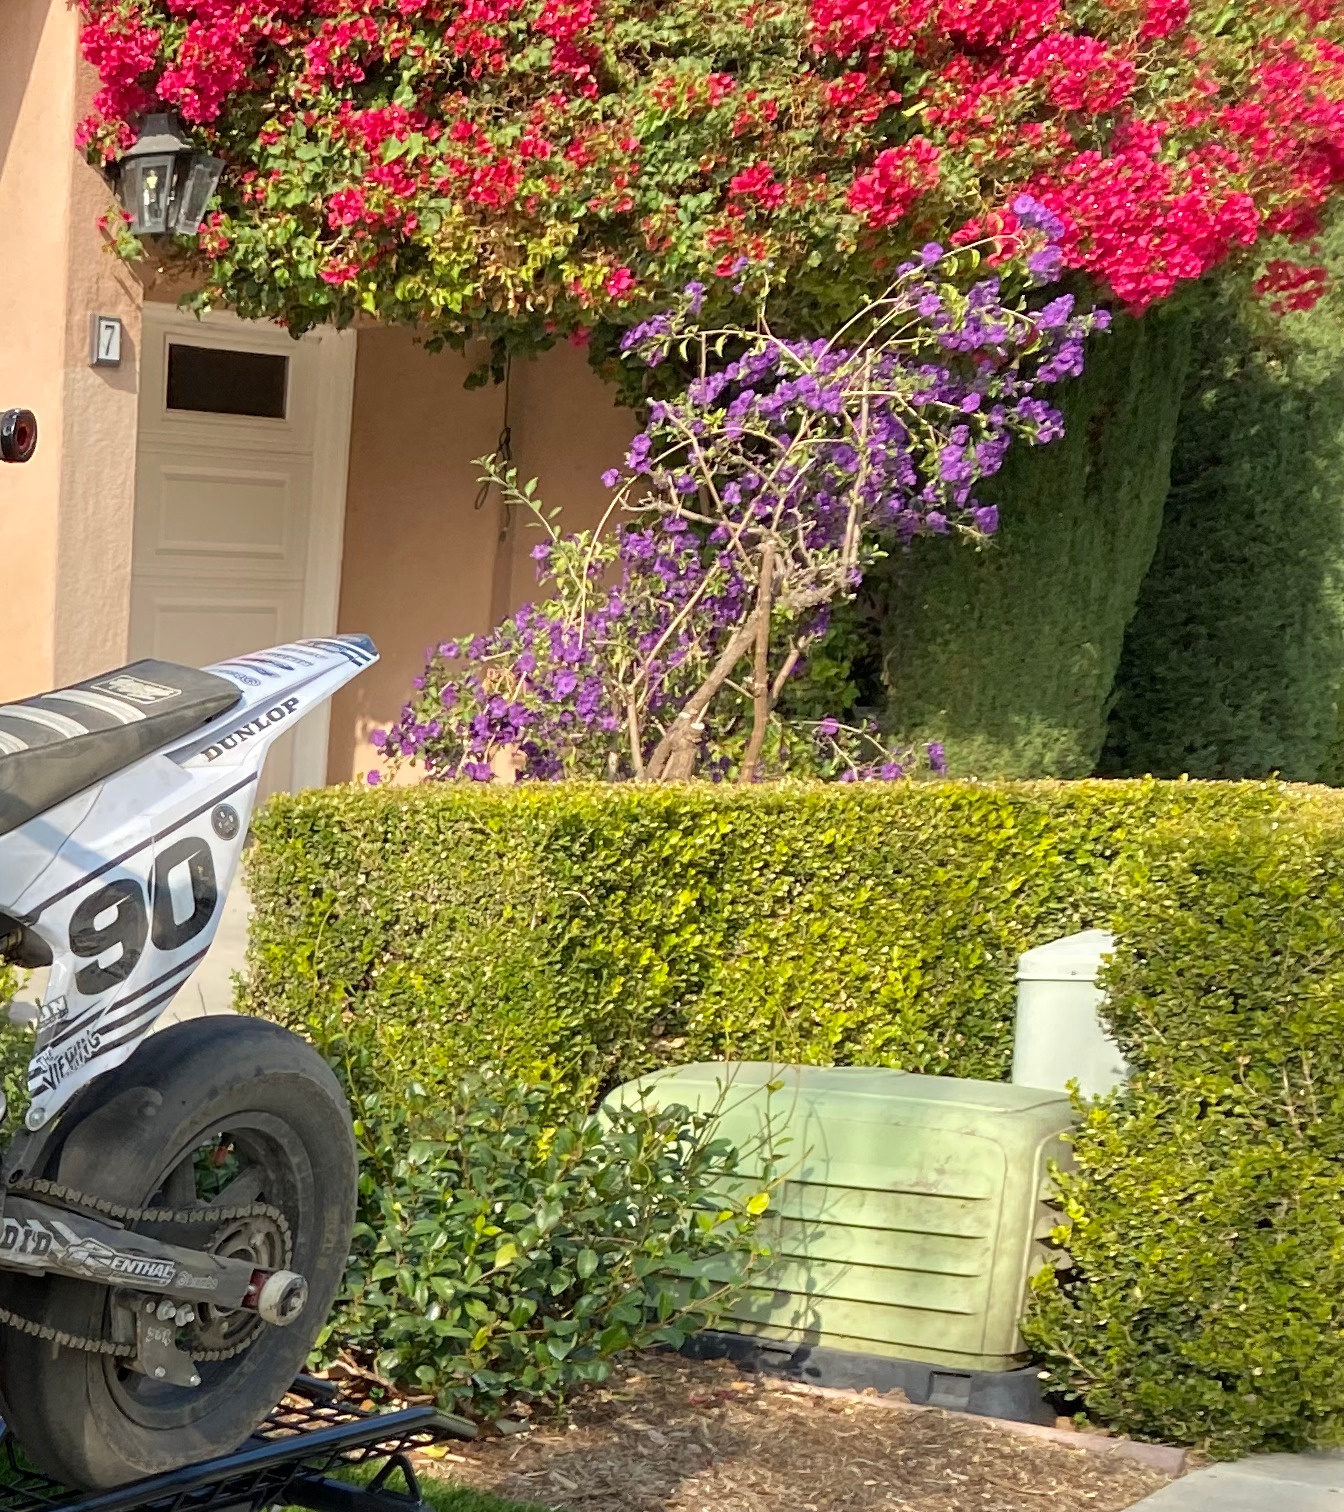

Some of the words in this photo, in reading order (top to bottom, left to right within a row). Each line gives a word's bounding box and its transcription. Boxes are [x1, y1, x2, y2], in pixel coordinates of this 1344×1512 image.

[104, 324, 116, 356] 7
[200, 696, 301, 763] DUNLOP
[68, 836, 218, 996] 90
